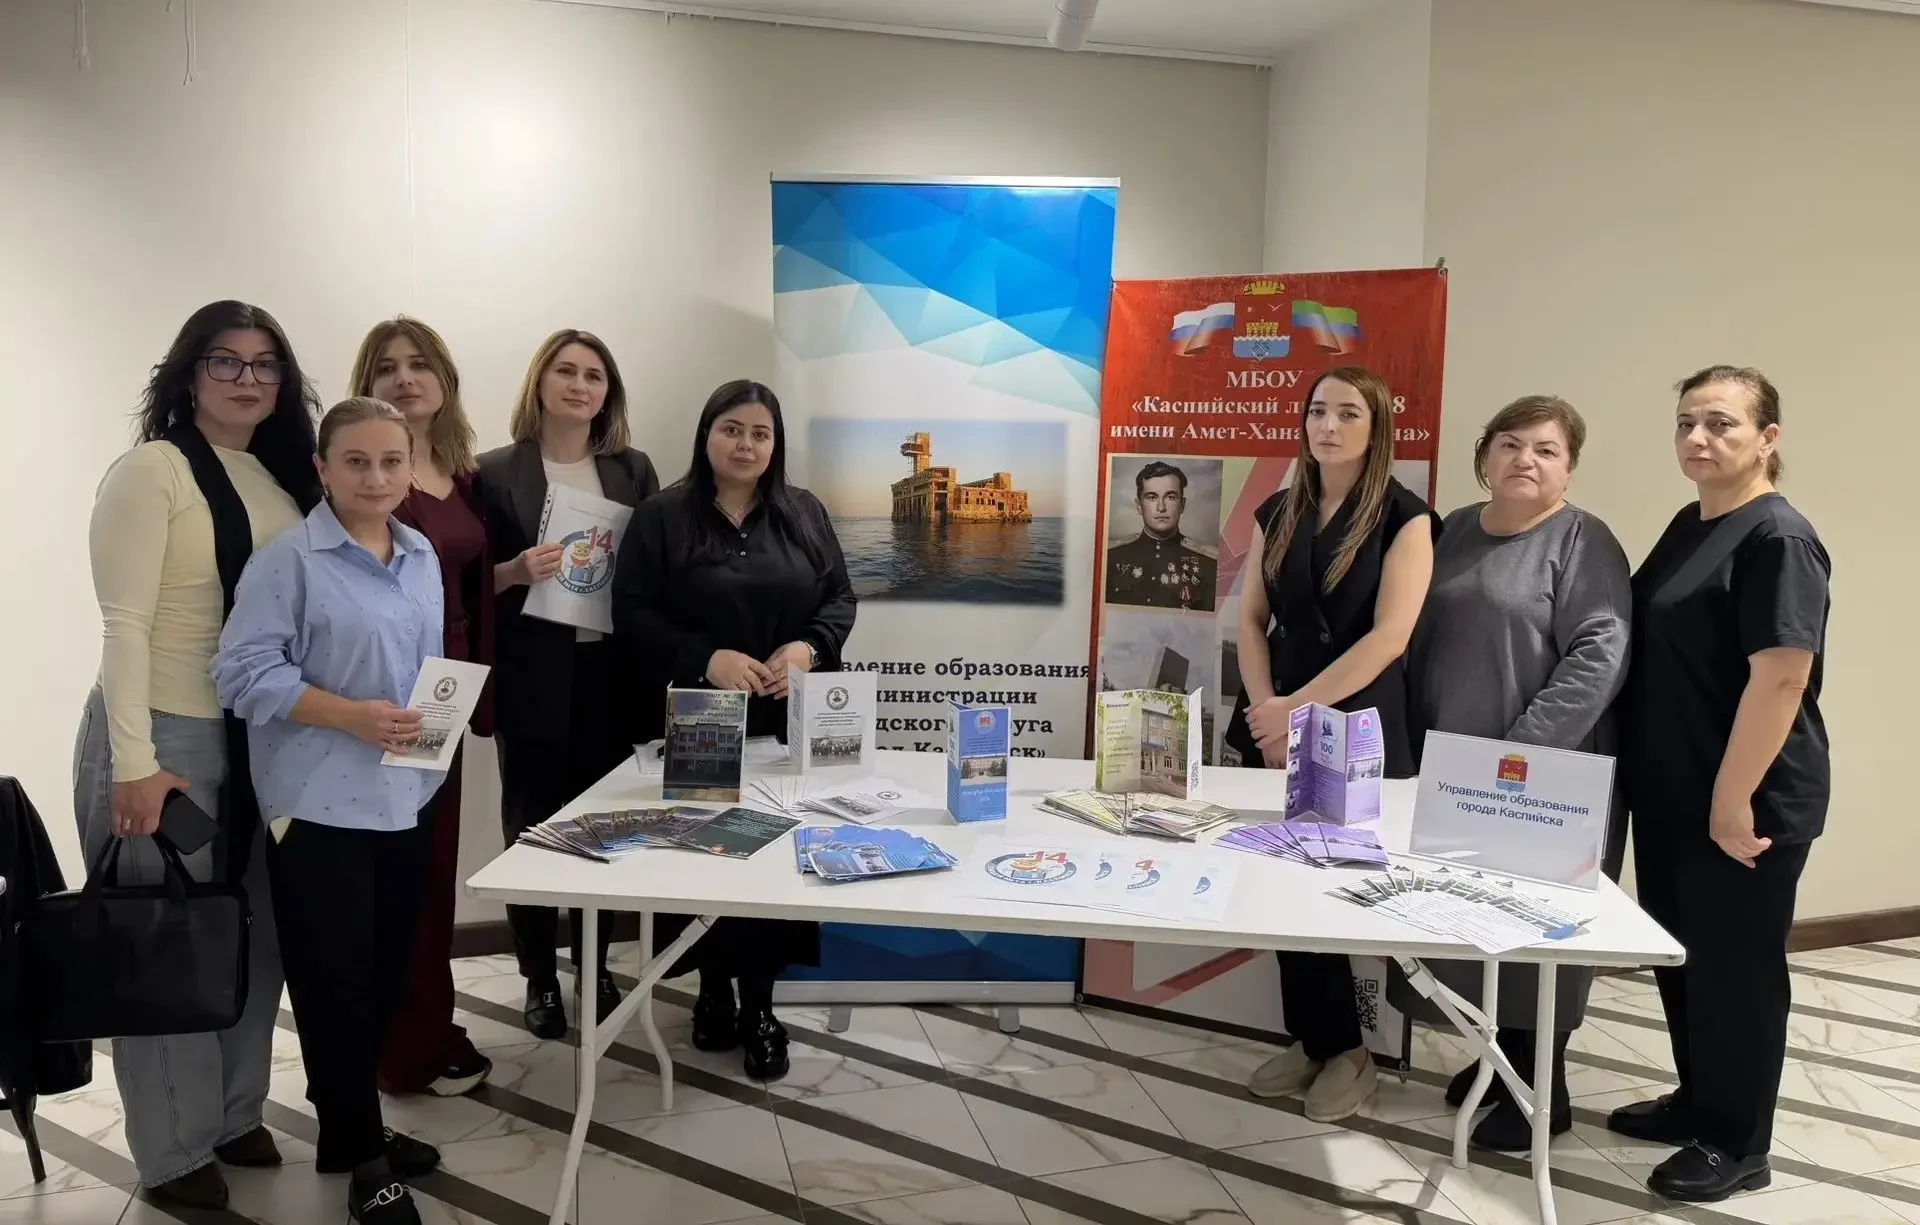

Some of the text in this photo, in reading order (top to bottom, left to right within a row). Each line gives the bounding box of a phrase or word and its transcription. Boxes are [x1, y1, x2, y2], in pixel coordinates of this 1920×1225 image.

[1226, 370, 1304, 388] МБОУ
[1132, 395, 1279, 414] «Каспийский
[1110, 424, 1175, 438] имени
[585, 525, 614, 554] 14
[841, 658, 1090, 681] вление образования
[877, 689, 1038, 706] инистрации
[876, 718, 946, 733] дског
[1012, 719, 1054, 737] уга
[1437, 780, 1589, 816] Управление образования
[1456, 801, 1564, 827] города Каспийска
[1135, 859, 1156, 870] 4
